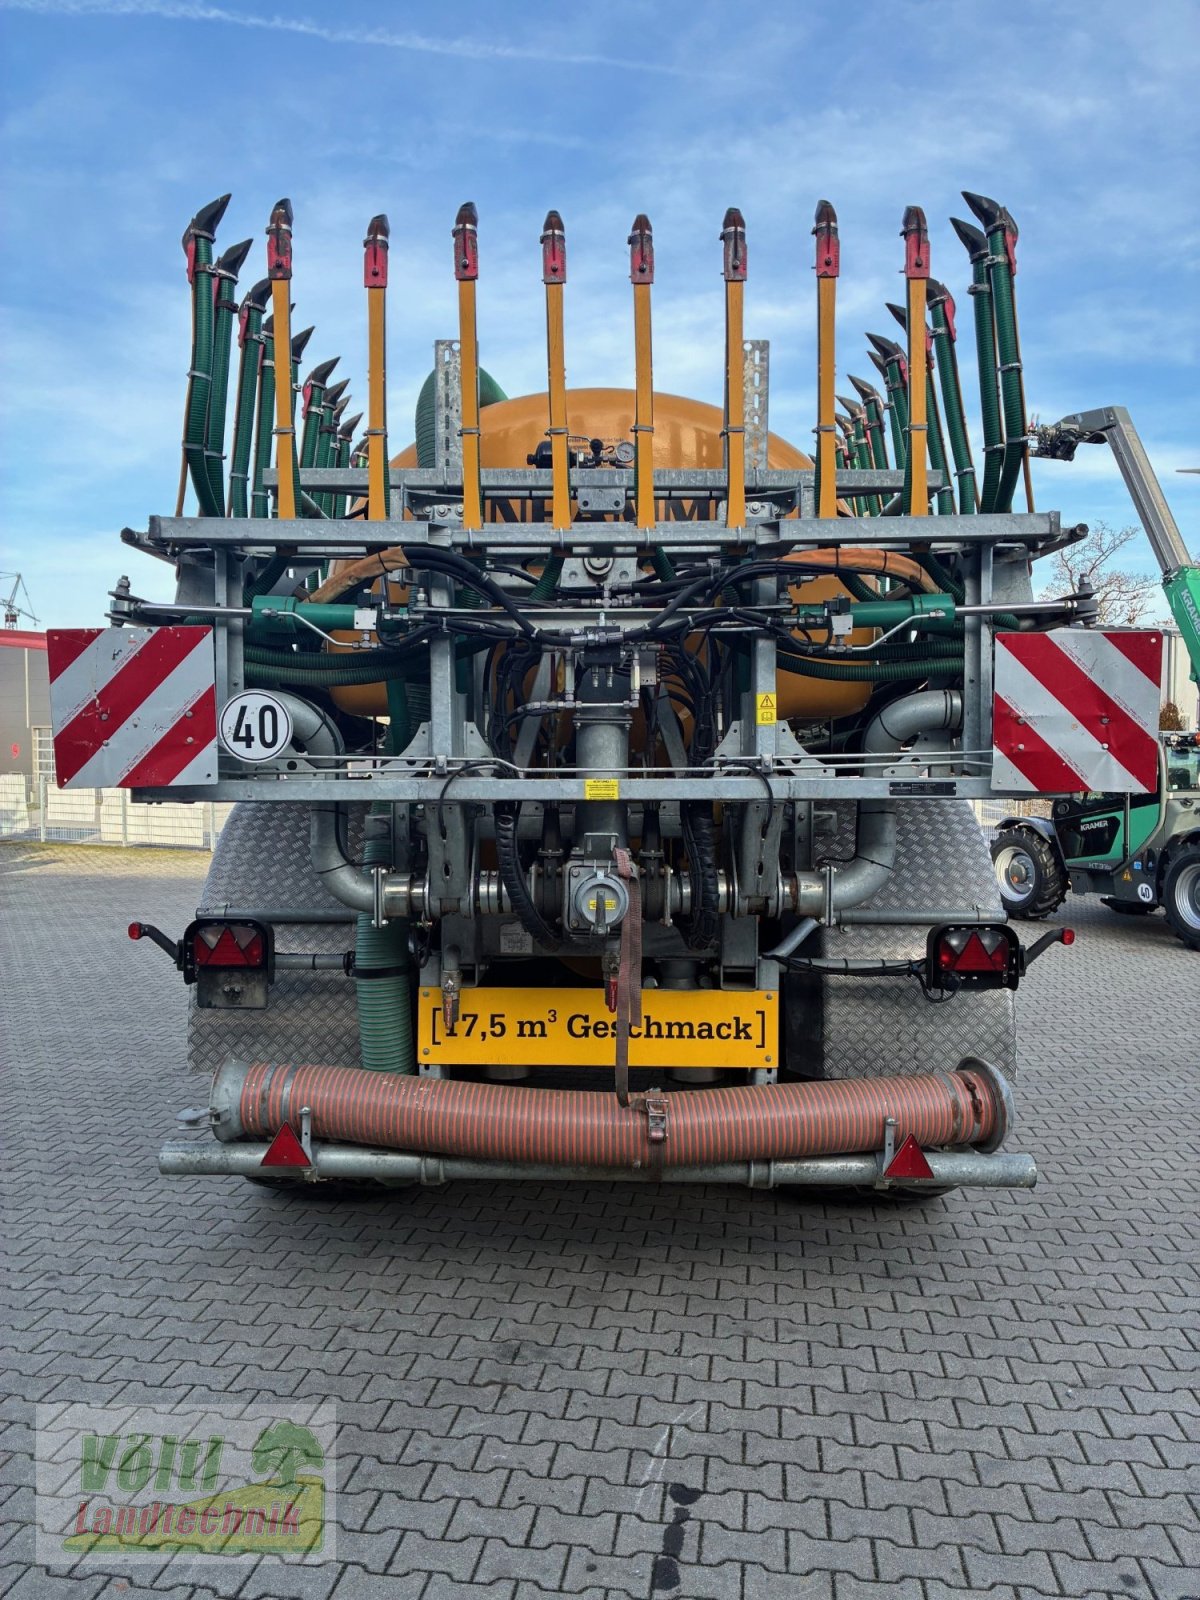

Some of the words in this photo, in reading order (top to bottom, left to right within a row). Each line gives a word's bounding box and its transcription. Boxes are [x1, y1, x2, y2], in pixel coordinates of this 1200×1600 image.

[233, 704, 278, 749] 40
[1080, 820, 1108, 832] KRAMER
[1140, 887, 1150, 899] 40
